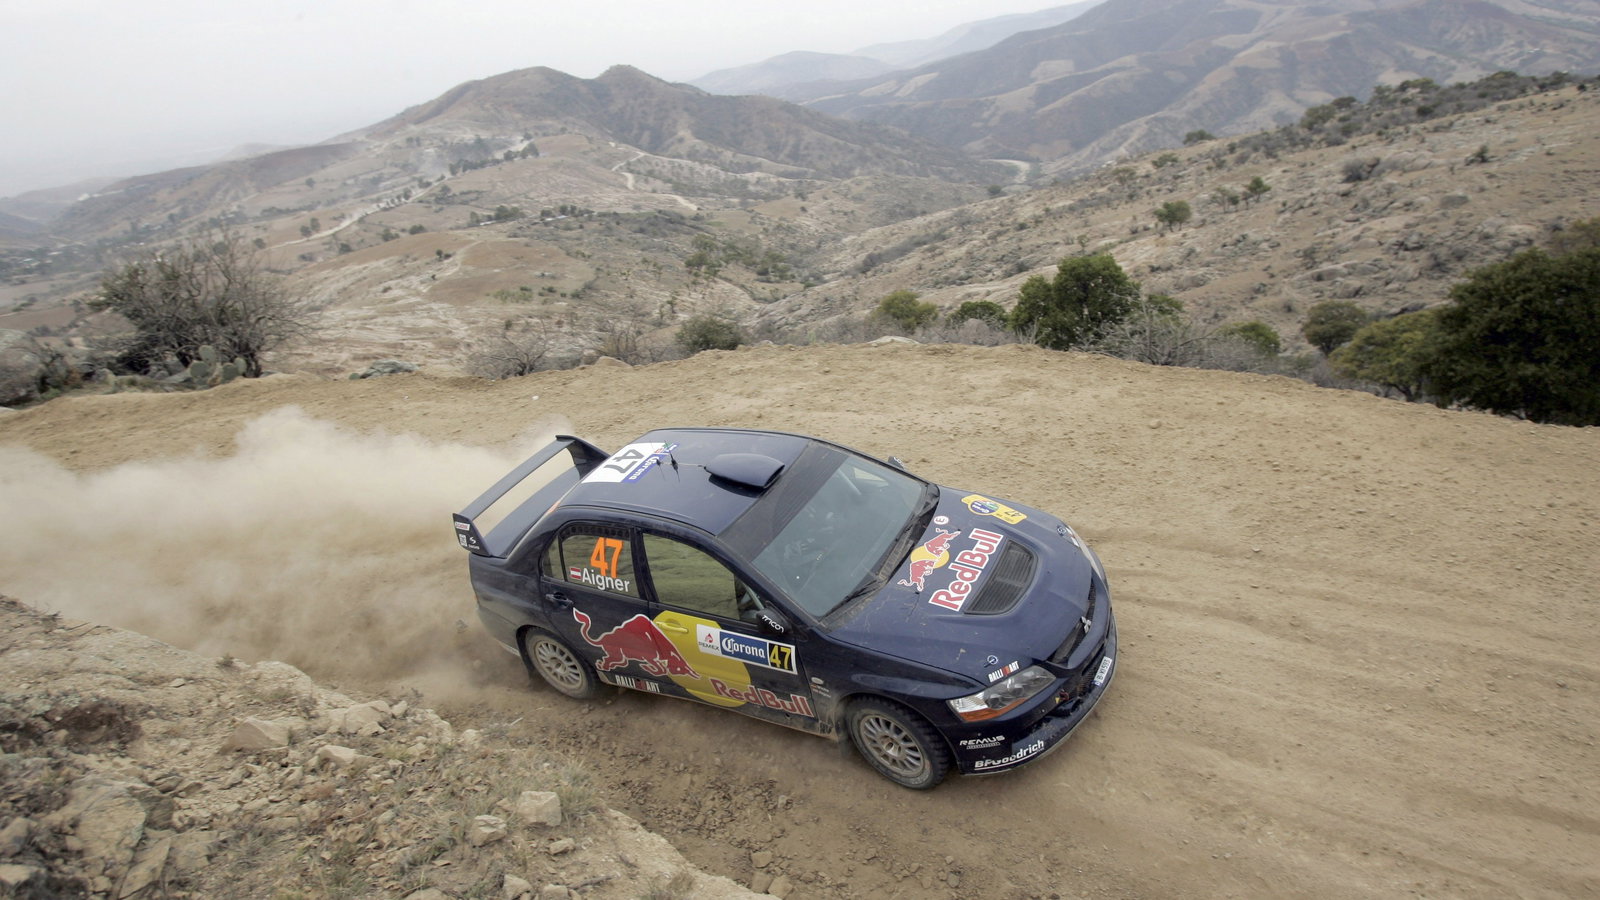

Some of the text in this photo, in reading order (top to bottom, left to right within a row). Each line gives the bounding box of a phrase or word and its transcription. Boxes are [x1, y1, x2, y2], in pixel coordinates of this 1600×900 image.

[603, 449, 645, 473] 47
[590, 537, 624, 579] 47
[582, 567, 630, 592] Aigner
[698, 641, 720, 652] PEMEX
[721, 637, 766, 659] Corona
[769, 644, 791, 670] 47
[959, 735, 1006, 746] REMUS
